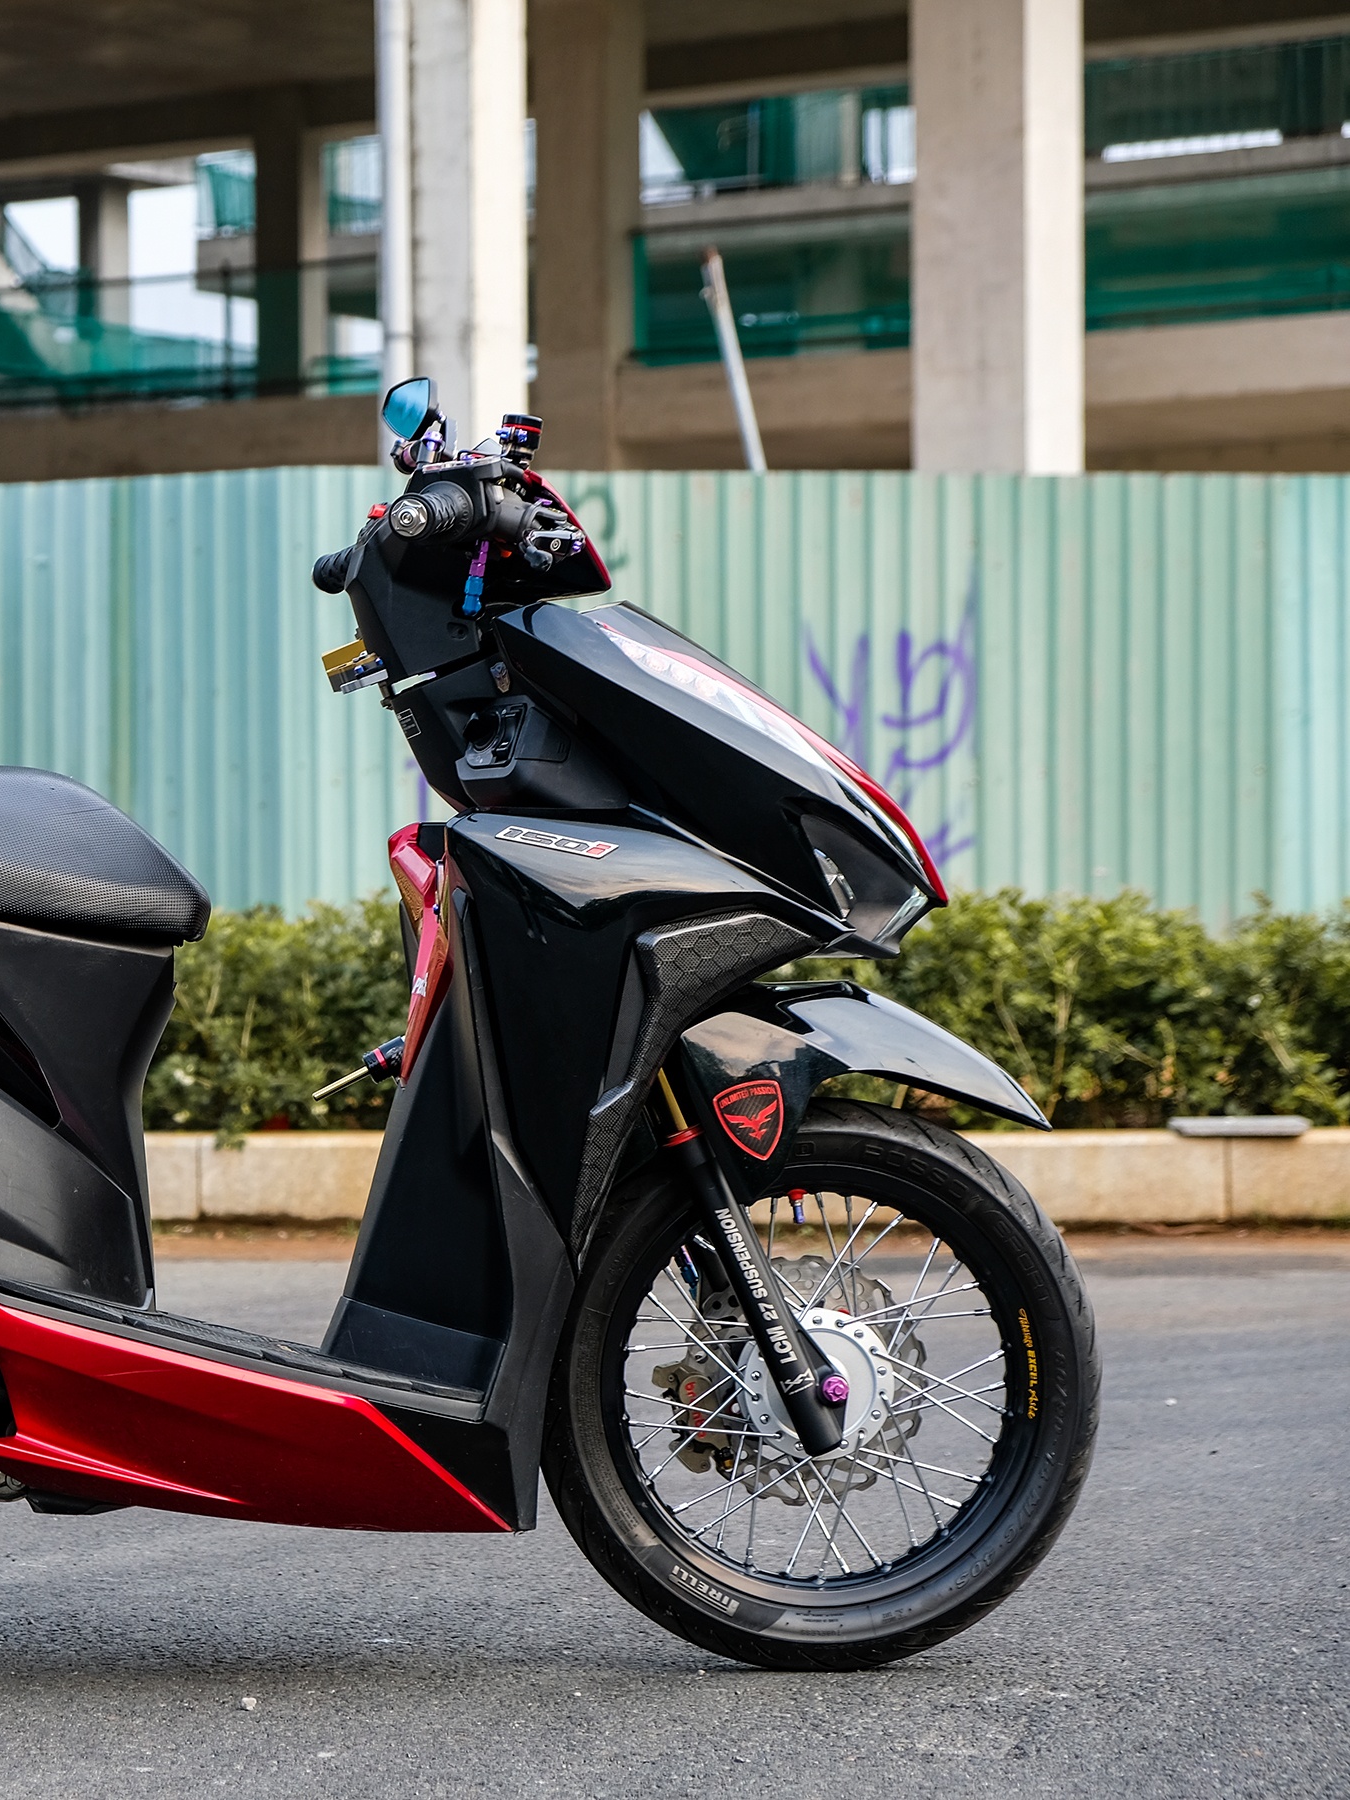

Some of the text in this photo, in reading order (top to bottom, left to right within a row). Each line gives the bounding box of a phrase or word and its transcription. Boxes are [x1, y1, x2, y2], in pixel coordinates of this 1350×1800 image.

[719, 1086, 777, 1109] UNLIMITED PASSION
[714, 1207, 798, 1364] LCM 27 SUSPENSION
[685, 1382, 707, 1439] brmbo
[668, 1564, 741, 1617] PIRELLI
